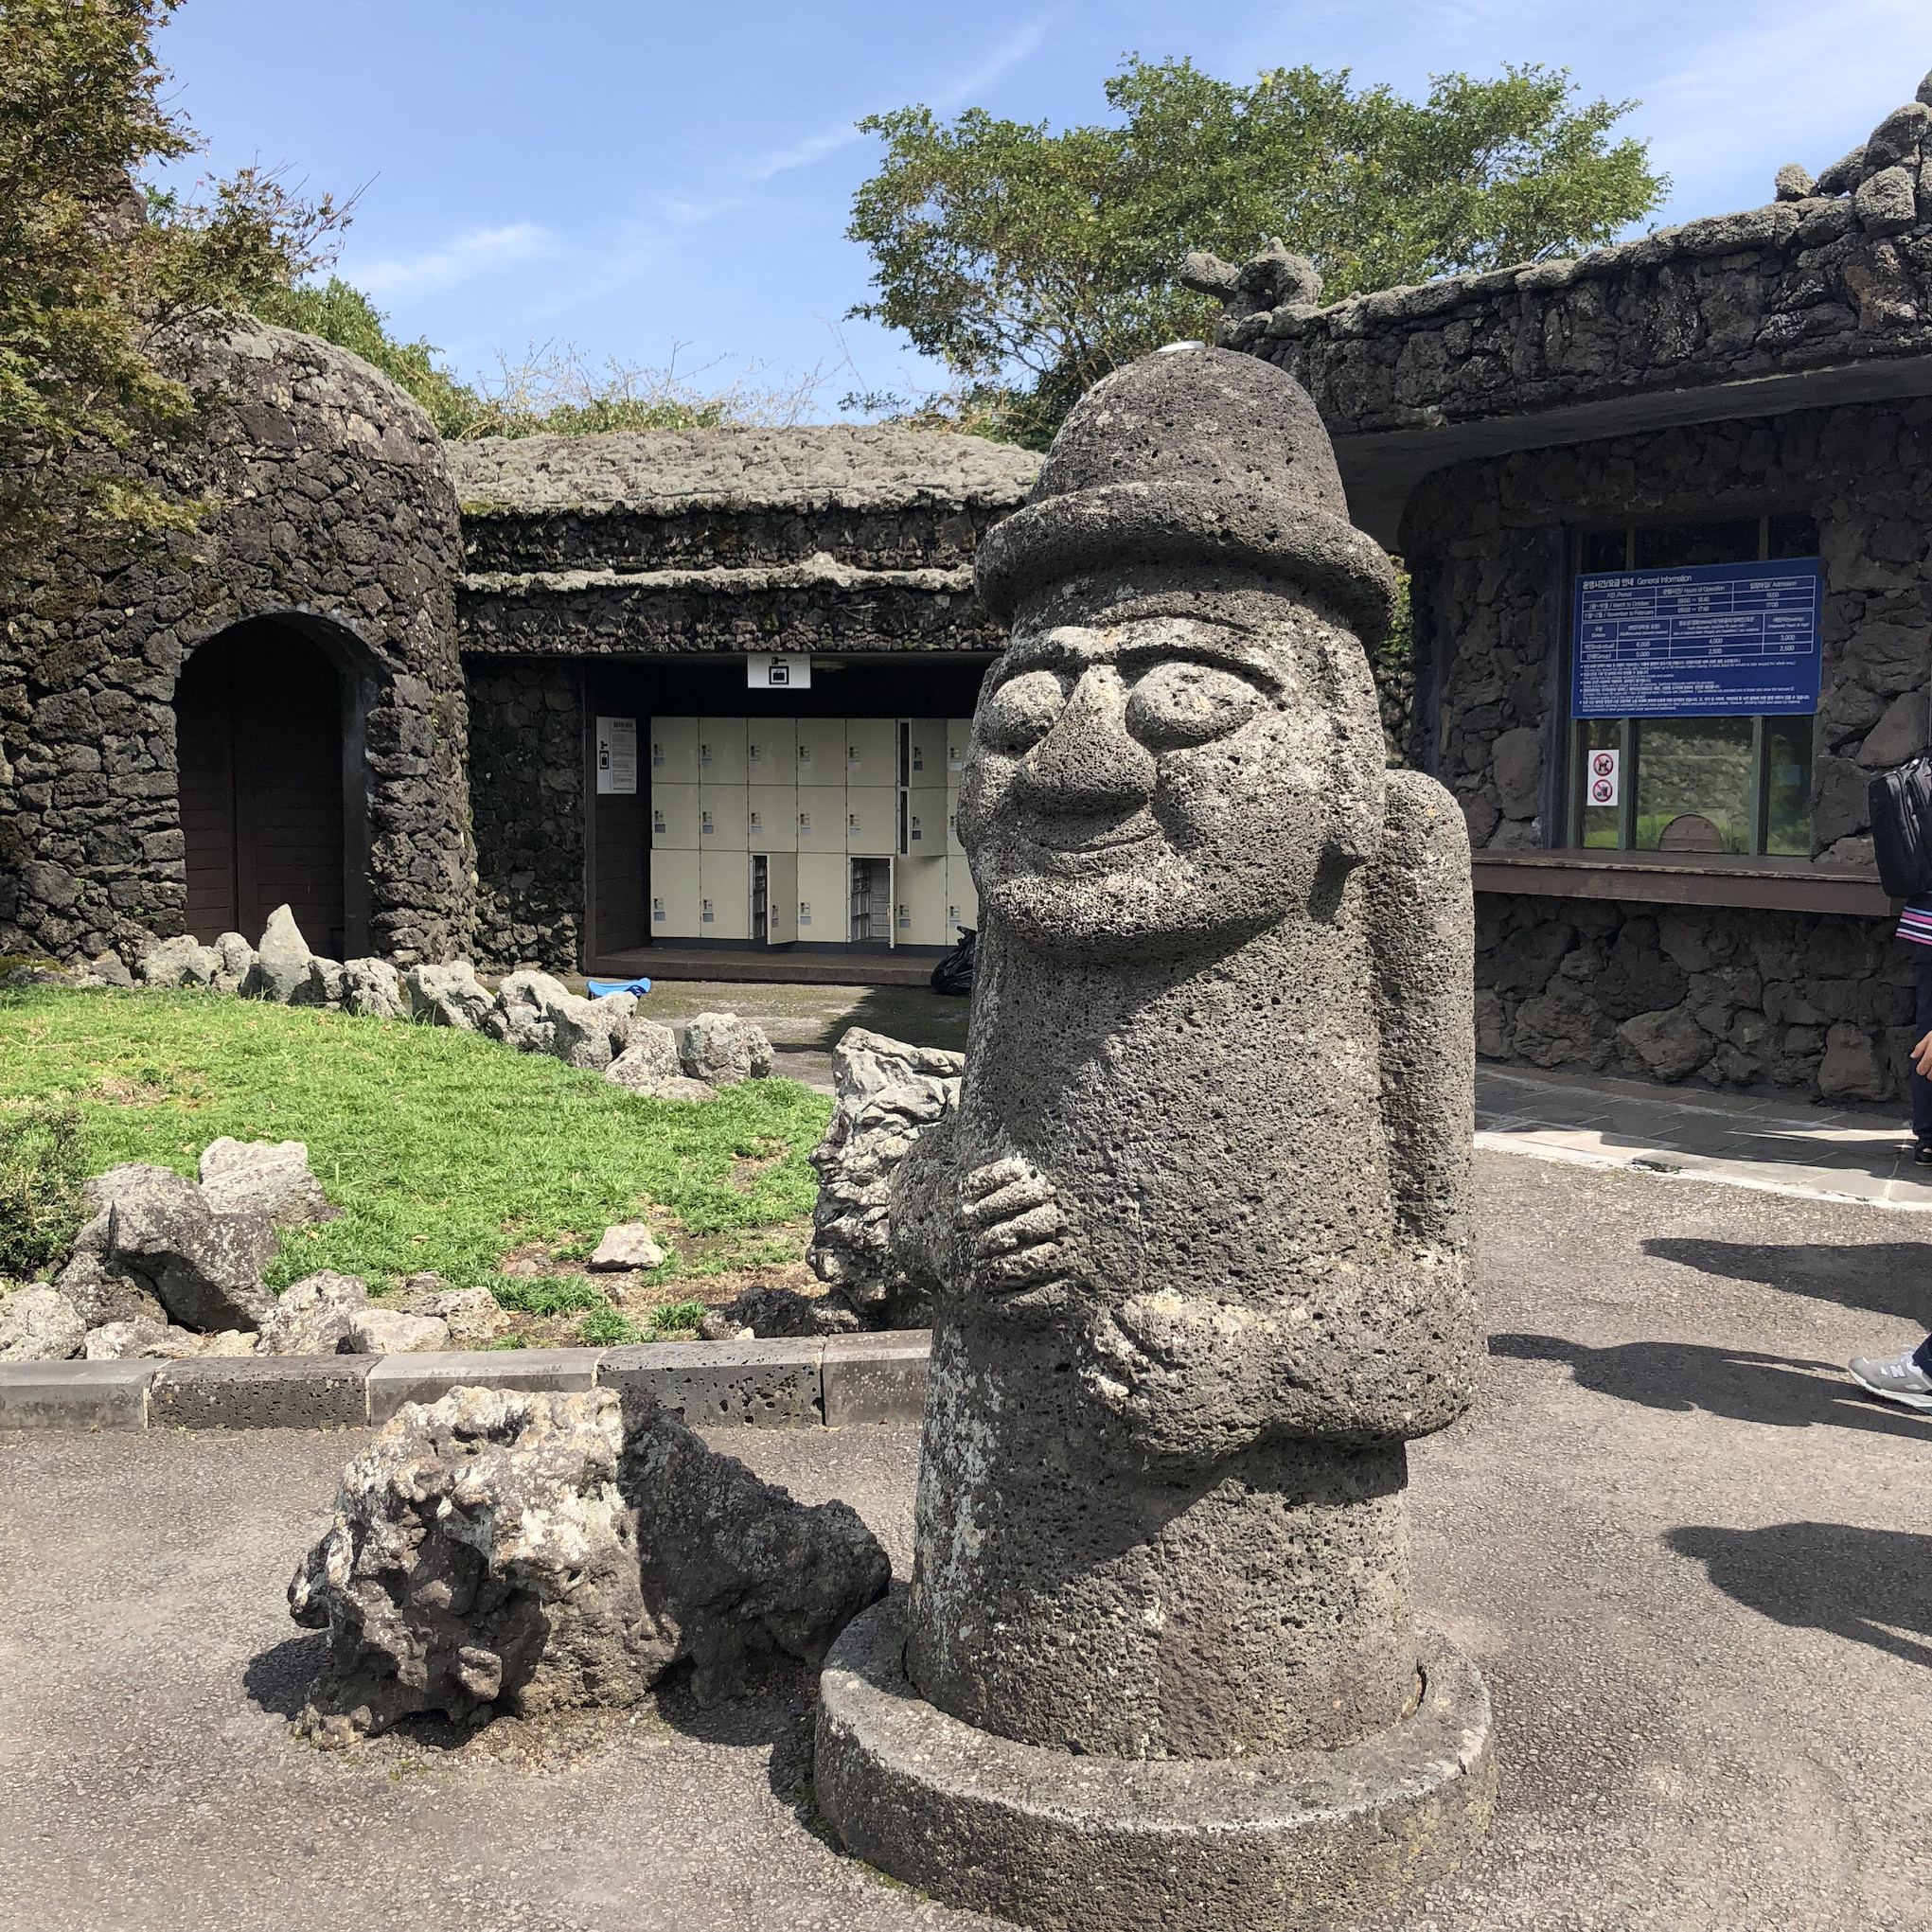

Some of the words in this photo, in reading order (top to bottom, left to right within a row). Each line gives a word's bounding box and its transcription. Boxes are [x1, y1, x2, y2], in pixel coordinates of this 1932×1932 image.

[1622, 577, 1634, 587] 안내
[1637, 576, 1659, 585] General
[1660, 575, 1692, 584] Information
[1889, 1365, 1905, 1378] N
